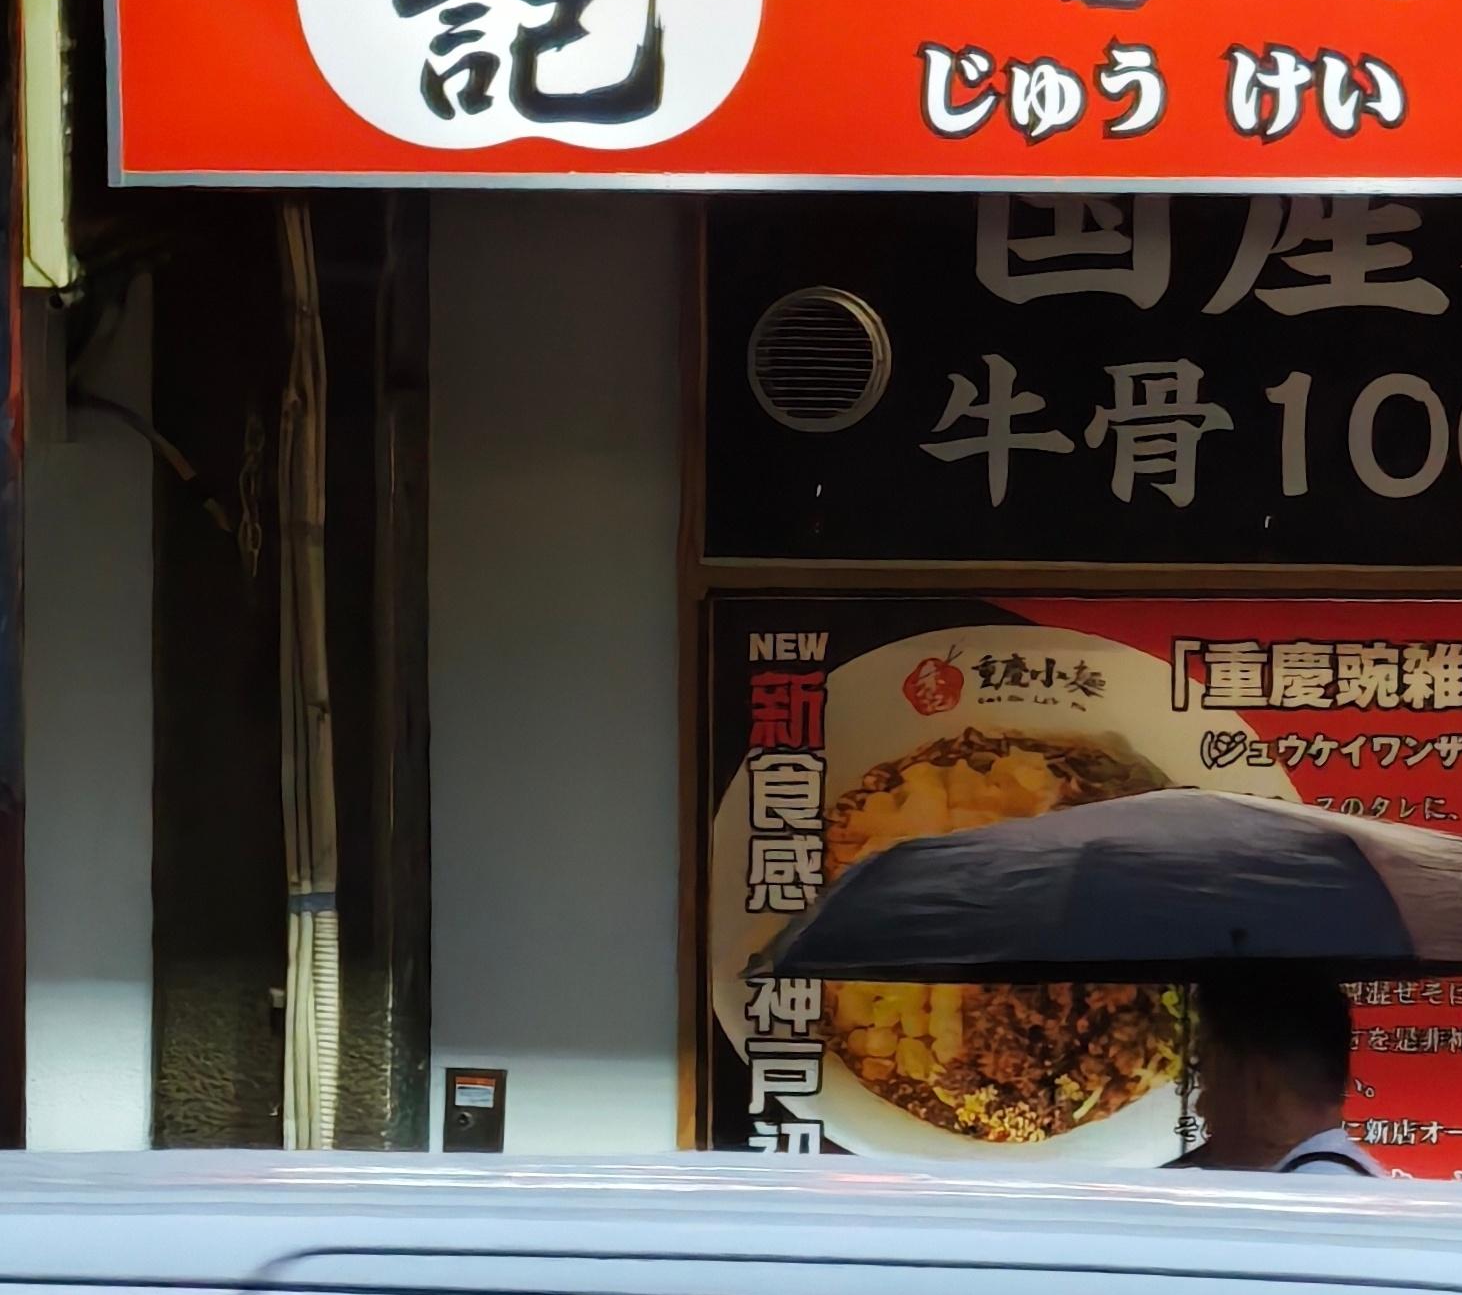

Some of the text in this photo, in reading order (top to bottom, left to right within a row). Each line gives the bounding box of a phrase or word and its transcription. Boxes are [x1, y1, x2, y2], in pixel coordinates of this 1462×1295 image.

[915, 38, 1167, 144] じゅう
[1223, 40, 1409, 144] けい
[748, 631, 829, 662] NEW
[746, 670, 826, 913] 新食感
